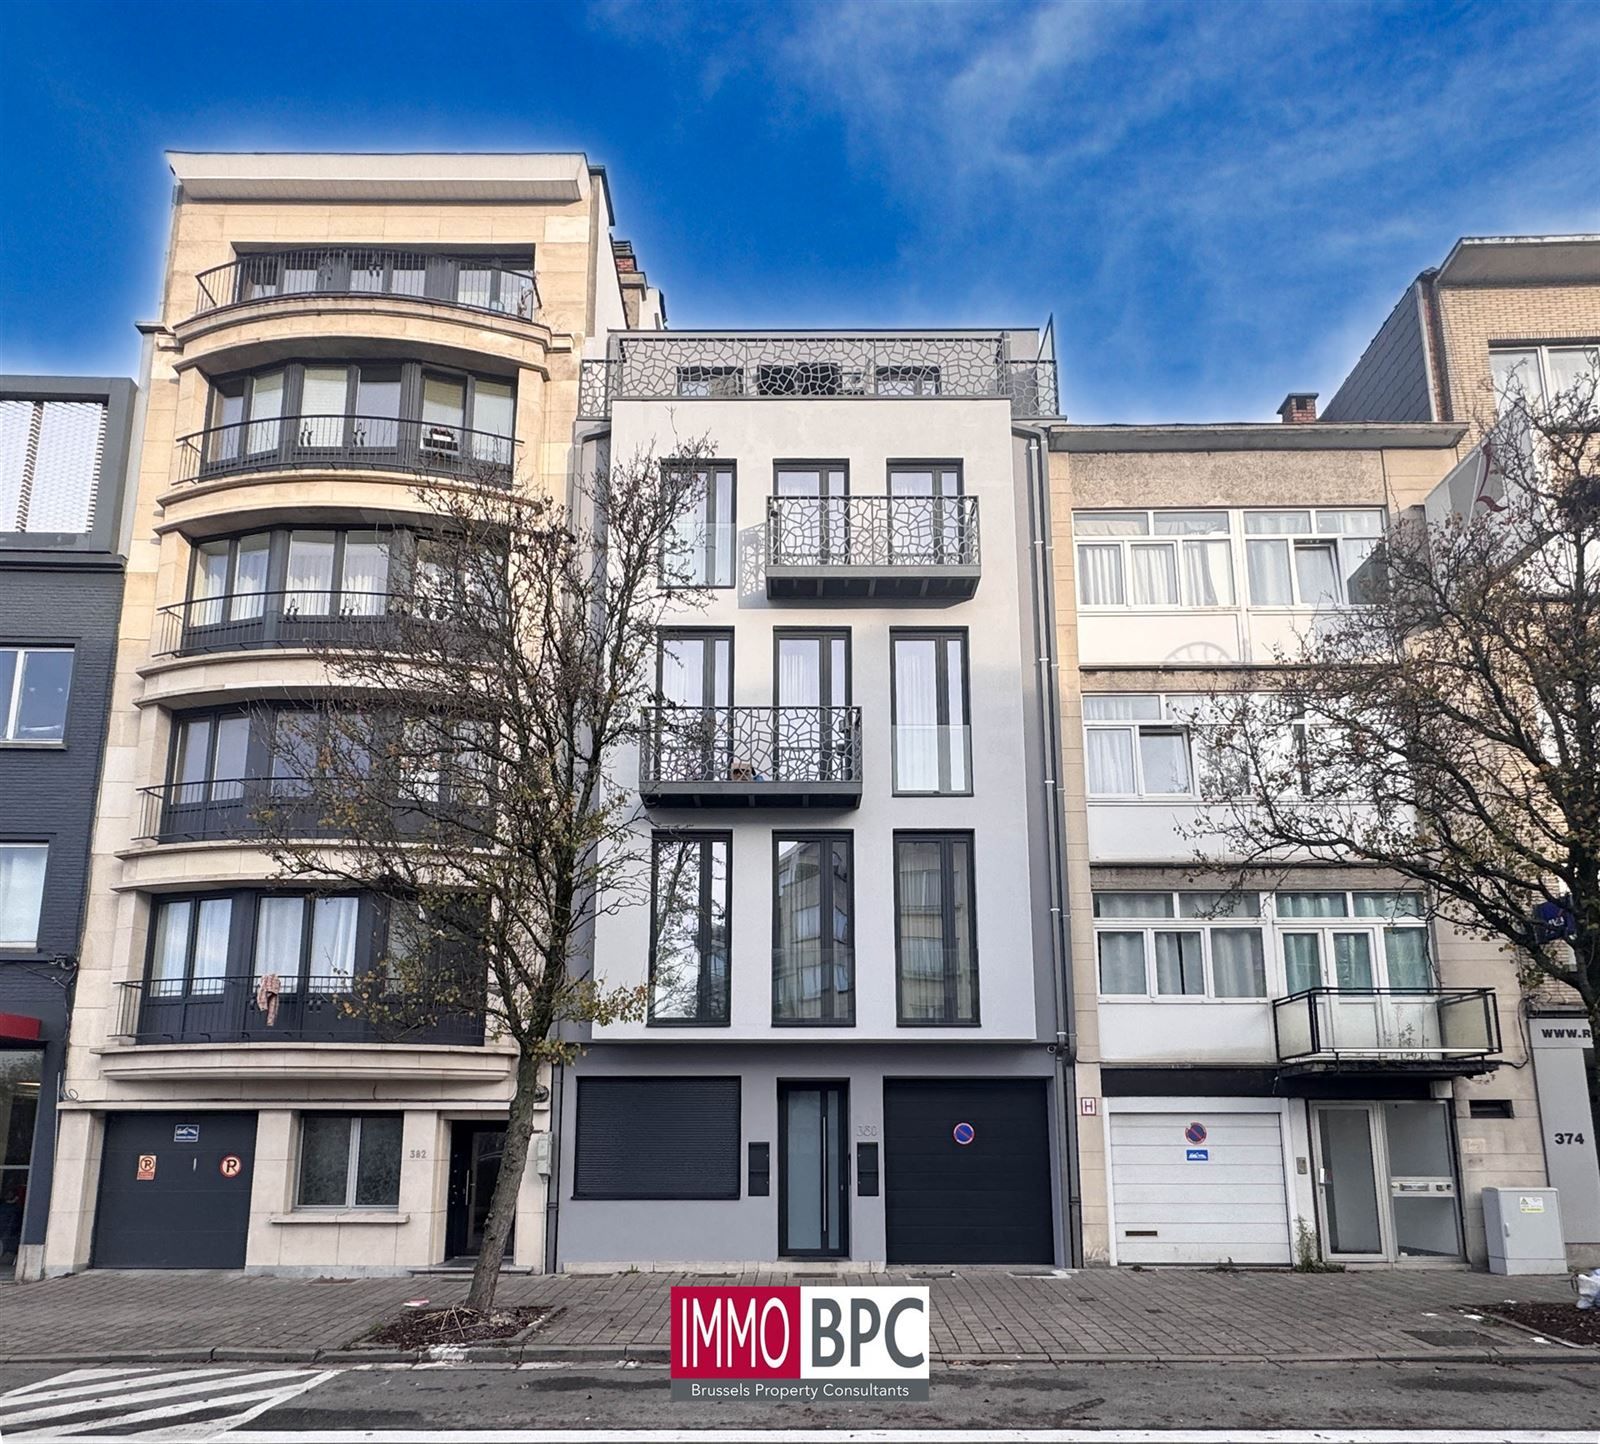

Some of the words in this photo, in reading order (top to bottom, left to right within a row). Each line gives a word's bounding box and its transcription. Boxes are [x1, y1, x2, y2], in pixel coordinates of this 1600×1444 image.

[1084, 1100, 1094, 1112] H
[857, 1124, 877, 1137] 380
[1555, 1133, 1585, 1144] 374
[410, 1150, 427, 1159] 382
